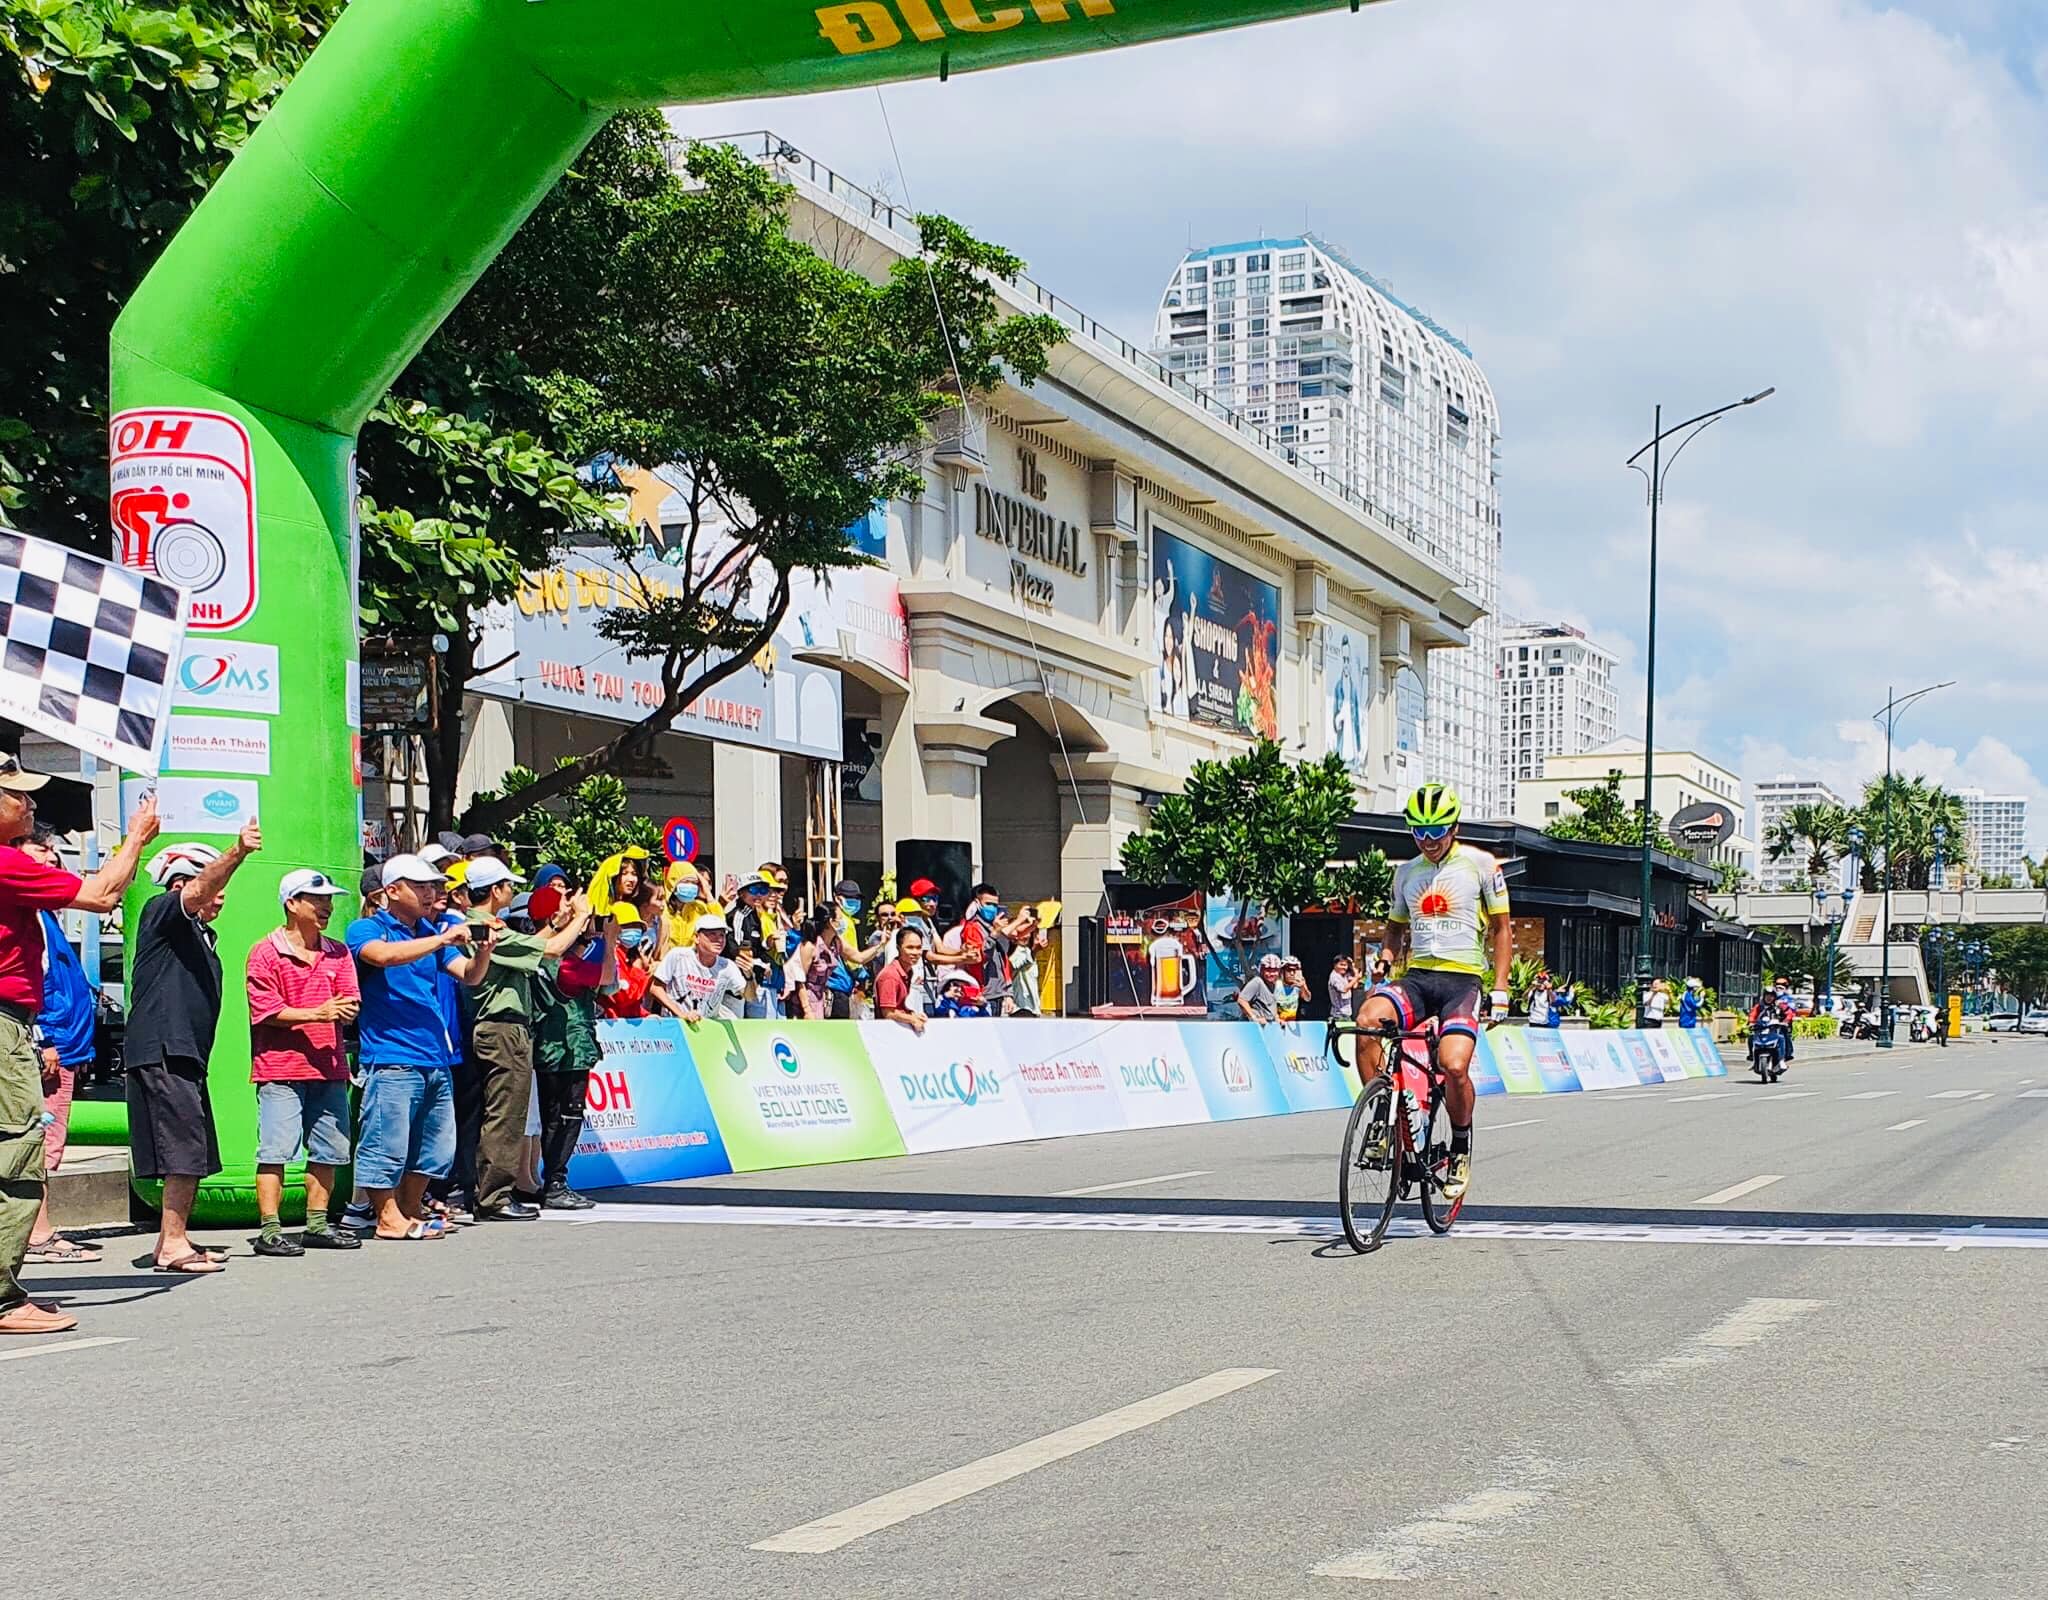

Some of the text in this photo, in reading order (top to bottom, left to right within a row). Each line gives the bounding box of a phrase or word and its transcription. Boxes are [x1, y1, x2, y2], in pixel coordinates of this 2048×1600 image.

[113, 420, 193, 453] OH
[196, 467, 225, 481] MINH
[975, 482, 1087, 578] IMPERIAL
[1010, 558, 1055, 610] Plaza
[1194, 615, 1238, 662] SHOPPING
[1212, 658, 1220, 679] &
[593, 672, 624, 700] TAU
[703, 696, 763, 730] MARKET
[1197, 678, 1234, 706] LA SIRENA
[171, 735, 207, 745] Honda
[211, 736, 226, 745] An
[1018, 1059, 1102, 1082] Honda An Thành
[753, 1083, 840, 1098] VIETNAM WASTE
[760, 1098, 849, 1118] SOLUTIONS
[583, 1113, 636, 1130] M99.9Mhz
